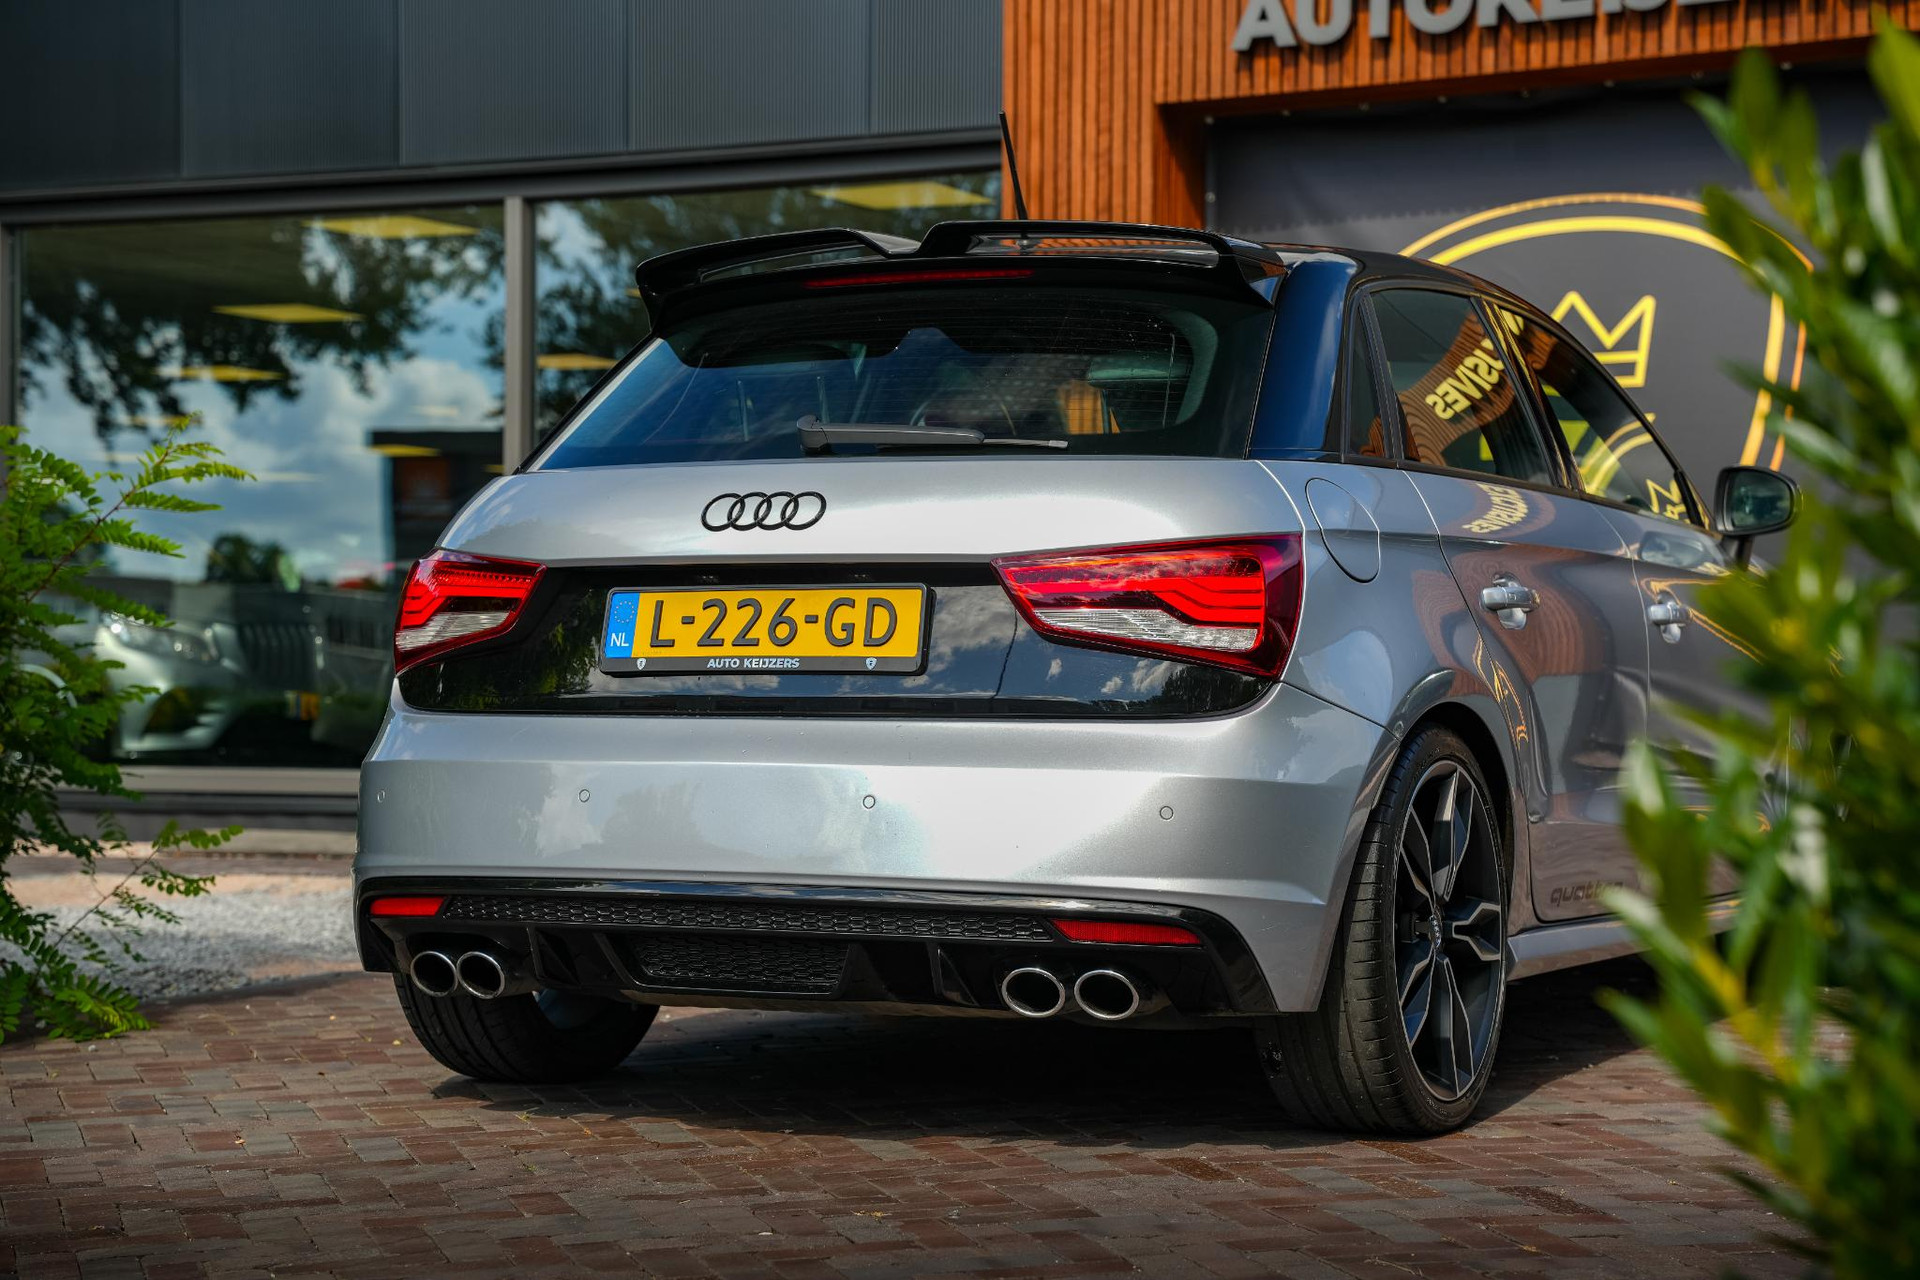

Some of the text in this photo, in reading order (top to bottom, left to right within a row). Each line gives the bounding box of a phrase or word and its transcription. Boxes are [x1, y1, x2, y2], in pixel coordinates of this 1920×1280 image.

[649, 597, 898, 648] L-226-GD
[609, 632, 630, 647] NL
[706, 657, 800, 669] AUTO KEIJZERS
[1550, 880, 1624, 908] quatt
